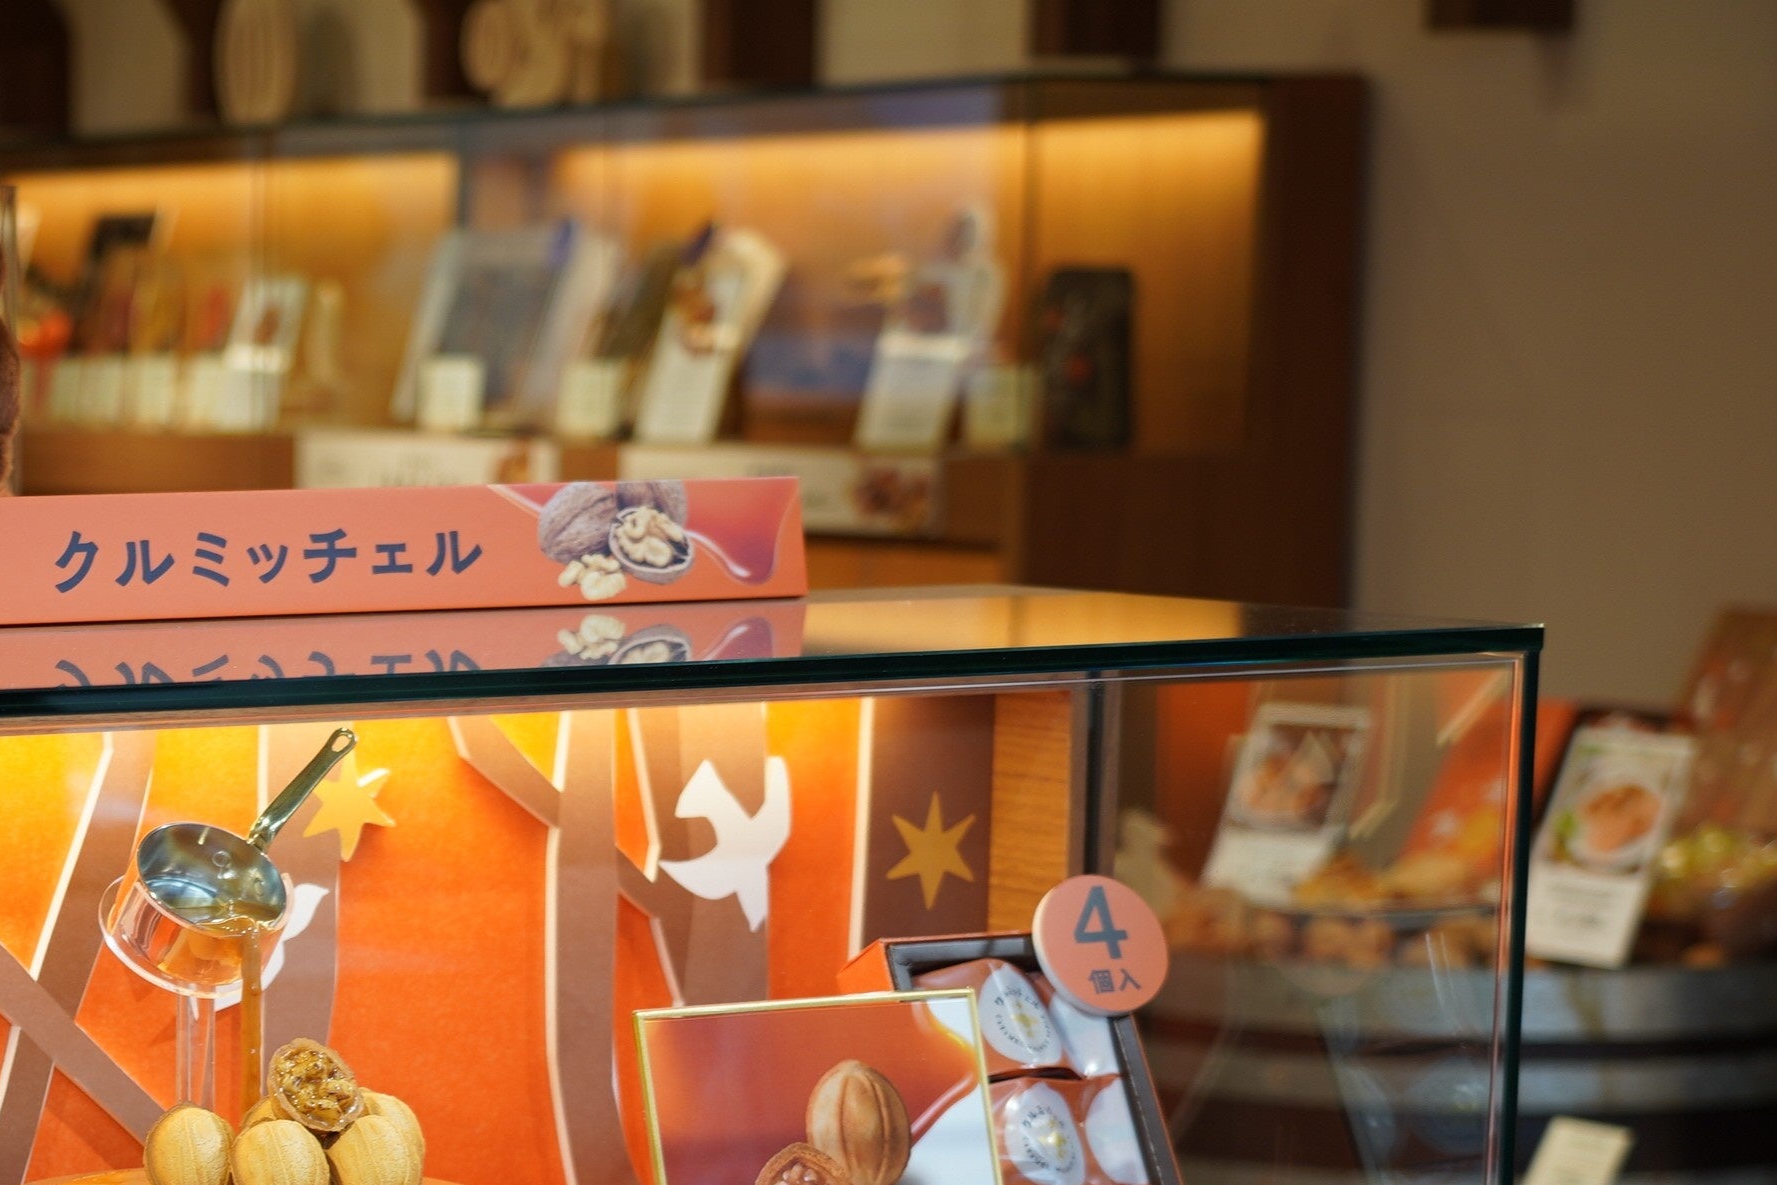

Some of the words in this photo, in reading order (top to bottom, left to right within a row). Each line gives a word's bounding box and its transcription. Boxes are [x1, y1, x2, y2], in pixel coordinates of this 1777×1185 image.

[55, 528, 483, 593] クルミッチェル
[1074, 886, 1128, 960] 4
[1089, 969, 1142, 995] 個入
